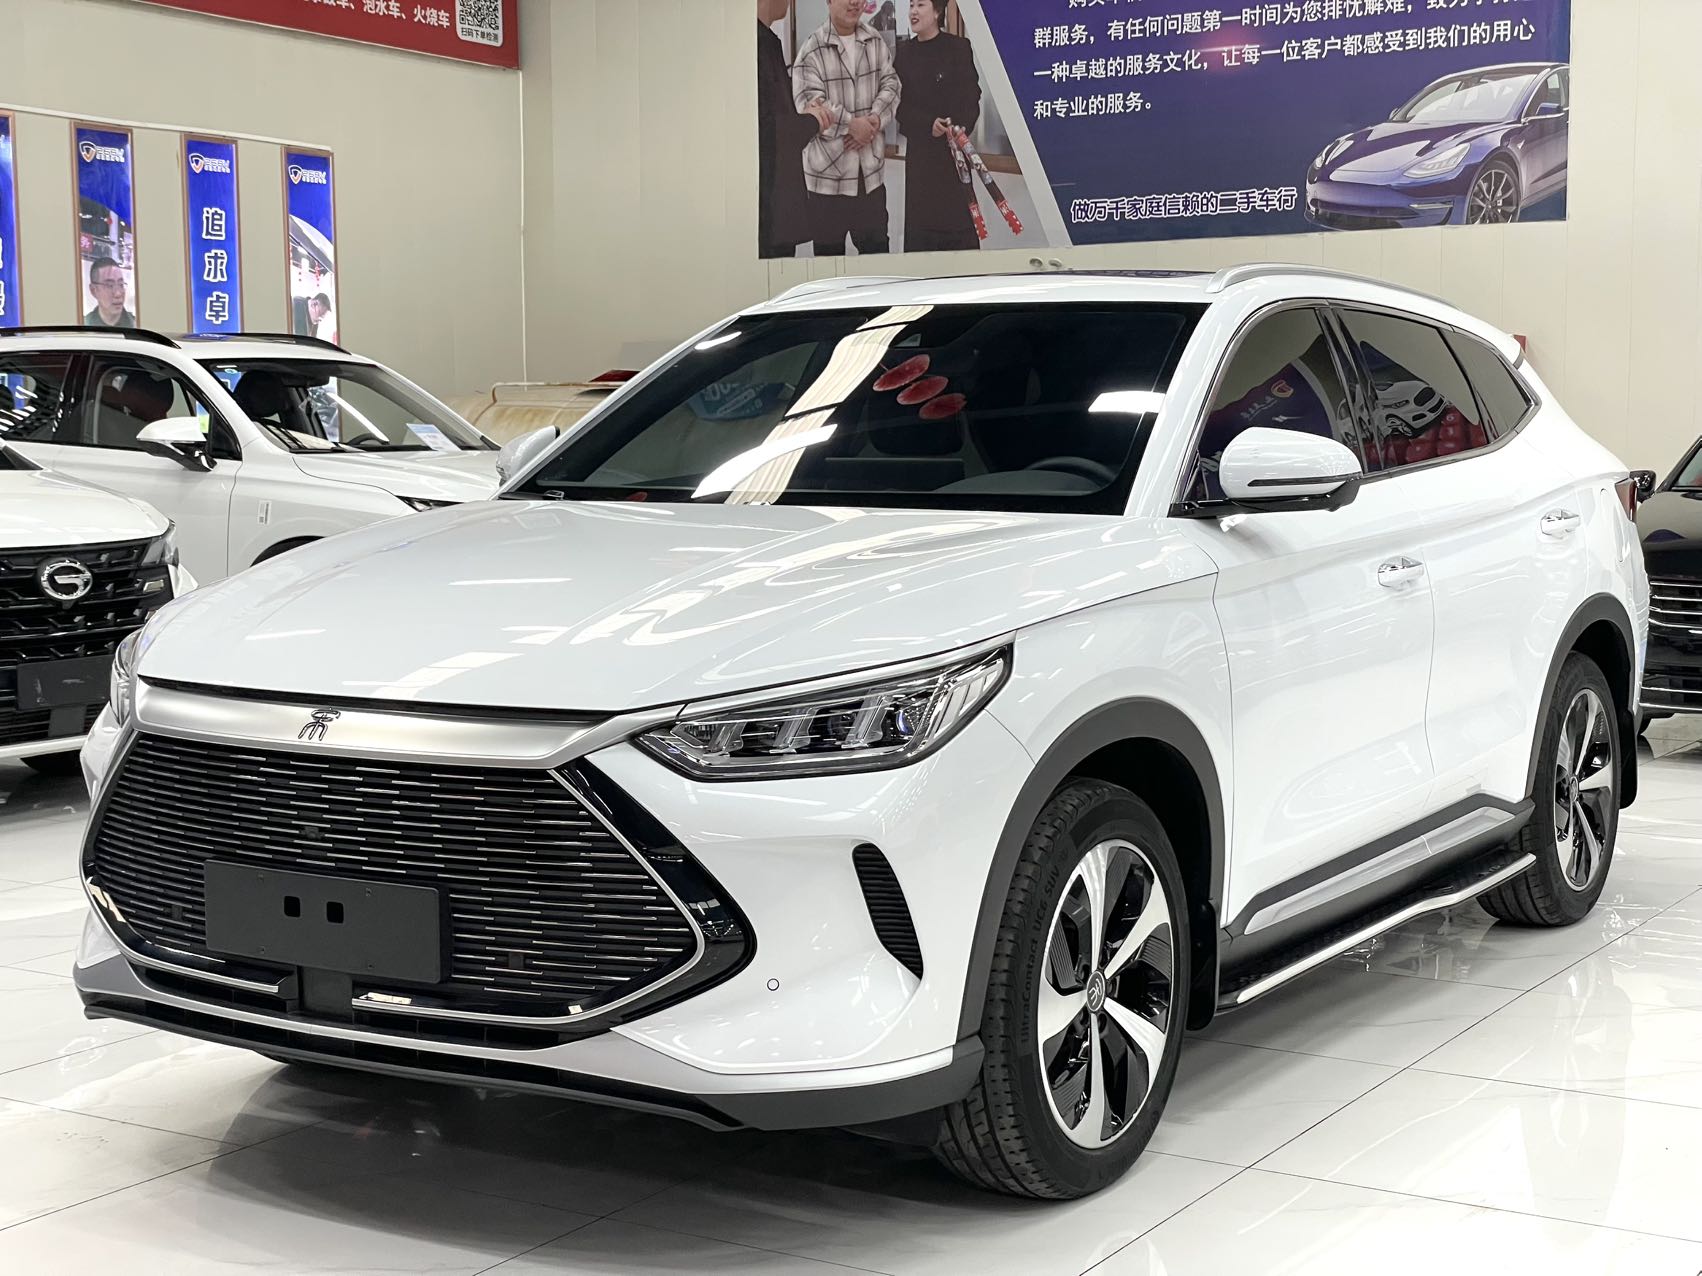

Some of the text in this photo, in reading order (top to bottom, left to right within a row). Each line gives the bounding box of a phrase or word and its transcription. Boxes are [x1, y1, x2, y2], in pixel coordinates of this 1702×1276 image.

[1033, 17, 1536, 83] 一种卓越的服务文化，让每一位客户都感受到我们的用心
[1033, 91, 1153, 120] 和专业的服务。
[1071, 187, 1298, 223] 做万千家庭信赖的二手车行
[202, 207, 229, 324] 追求卓
